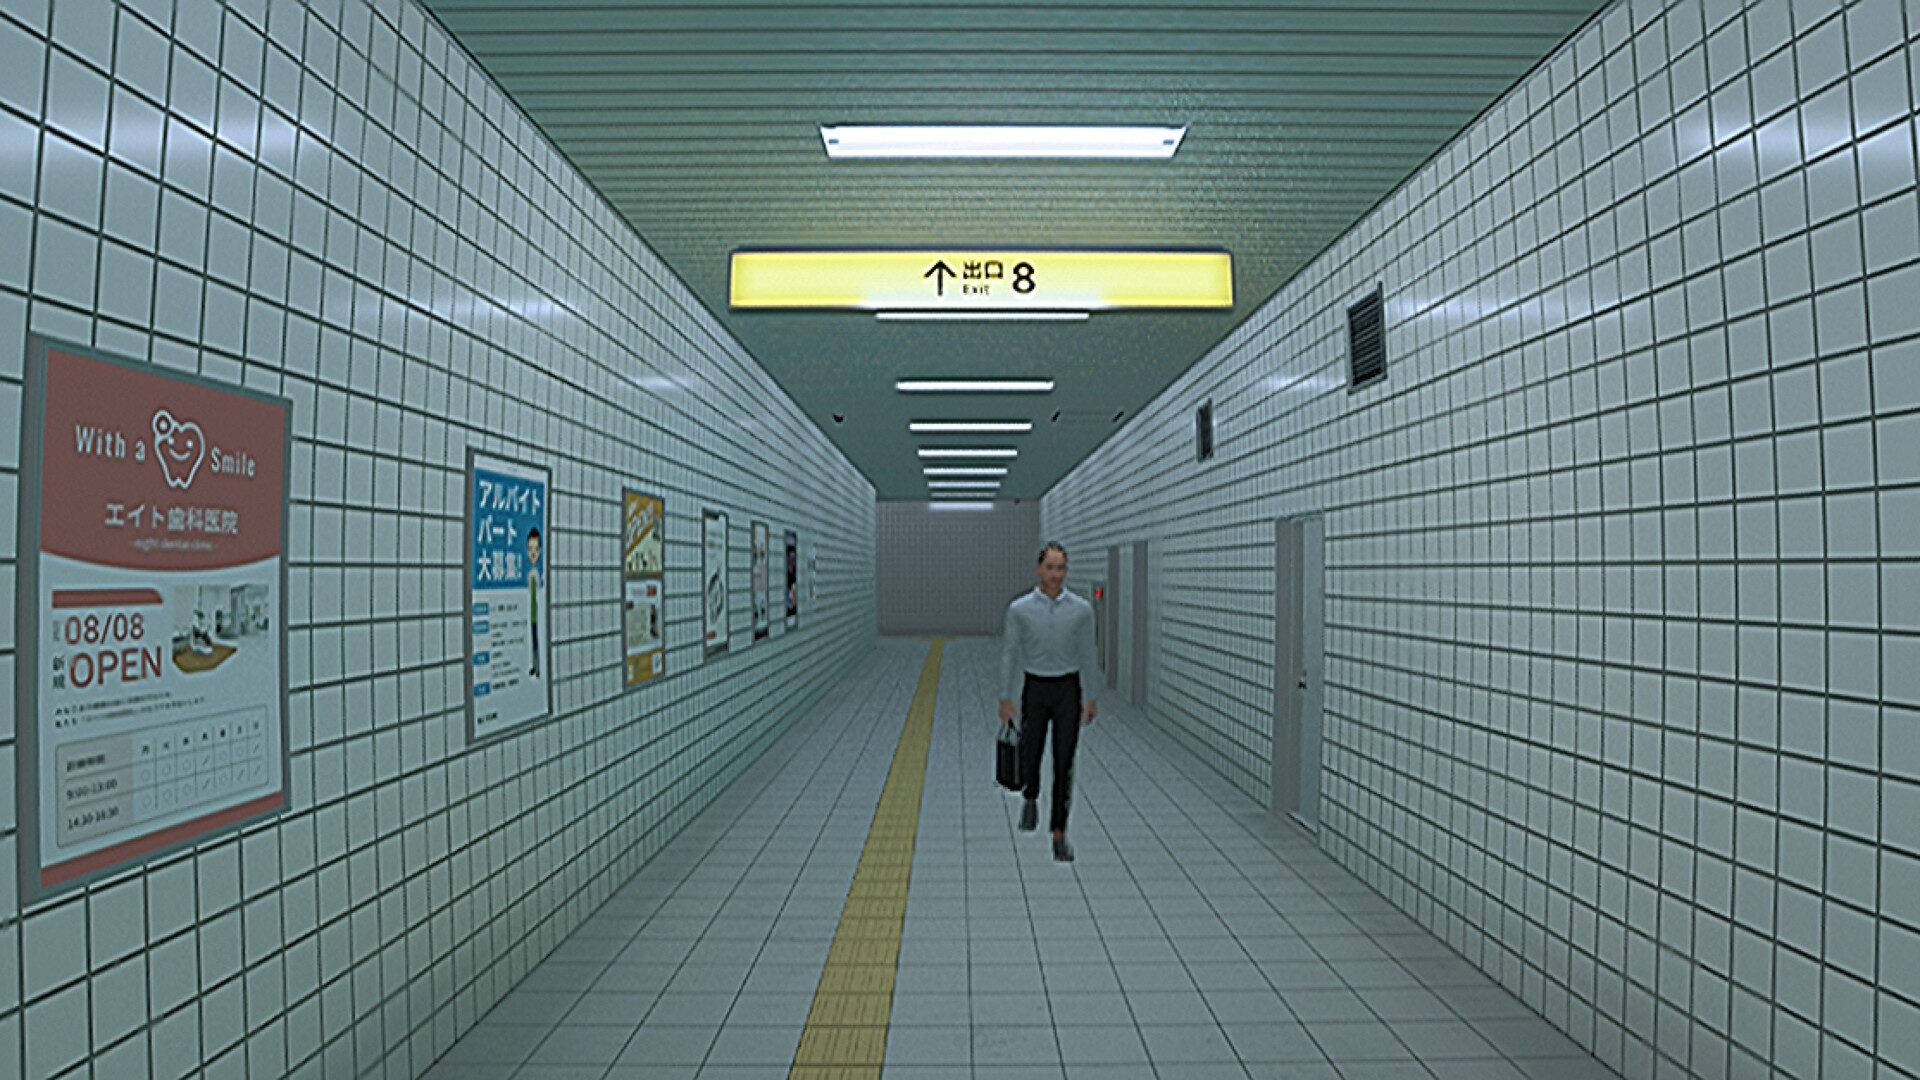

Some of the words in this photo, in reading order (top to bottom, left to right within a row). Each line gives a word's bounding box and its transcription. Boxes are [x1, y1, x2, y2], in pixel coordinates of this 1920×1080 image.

[963, 260, 1004, 280] 出口
[1012, 261, 1036, 294] 8
[963, 283, 991, 296] Exit
[75, 424, 126, 460] With
[134, 439, 146, 462] a
[211, 446, 256, 477] Smile
[479, 480, 541, 516] アルバイト
[104, 503, 239, 535] エイト歯科医院
[477, 514, 518, 547] パート
[65, 612, 145, 646] 08/08
[70, 646, 163, 689] OPEN
